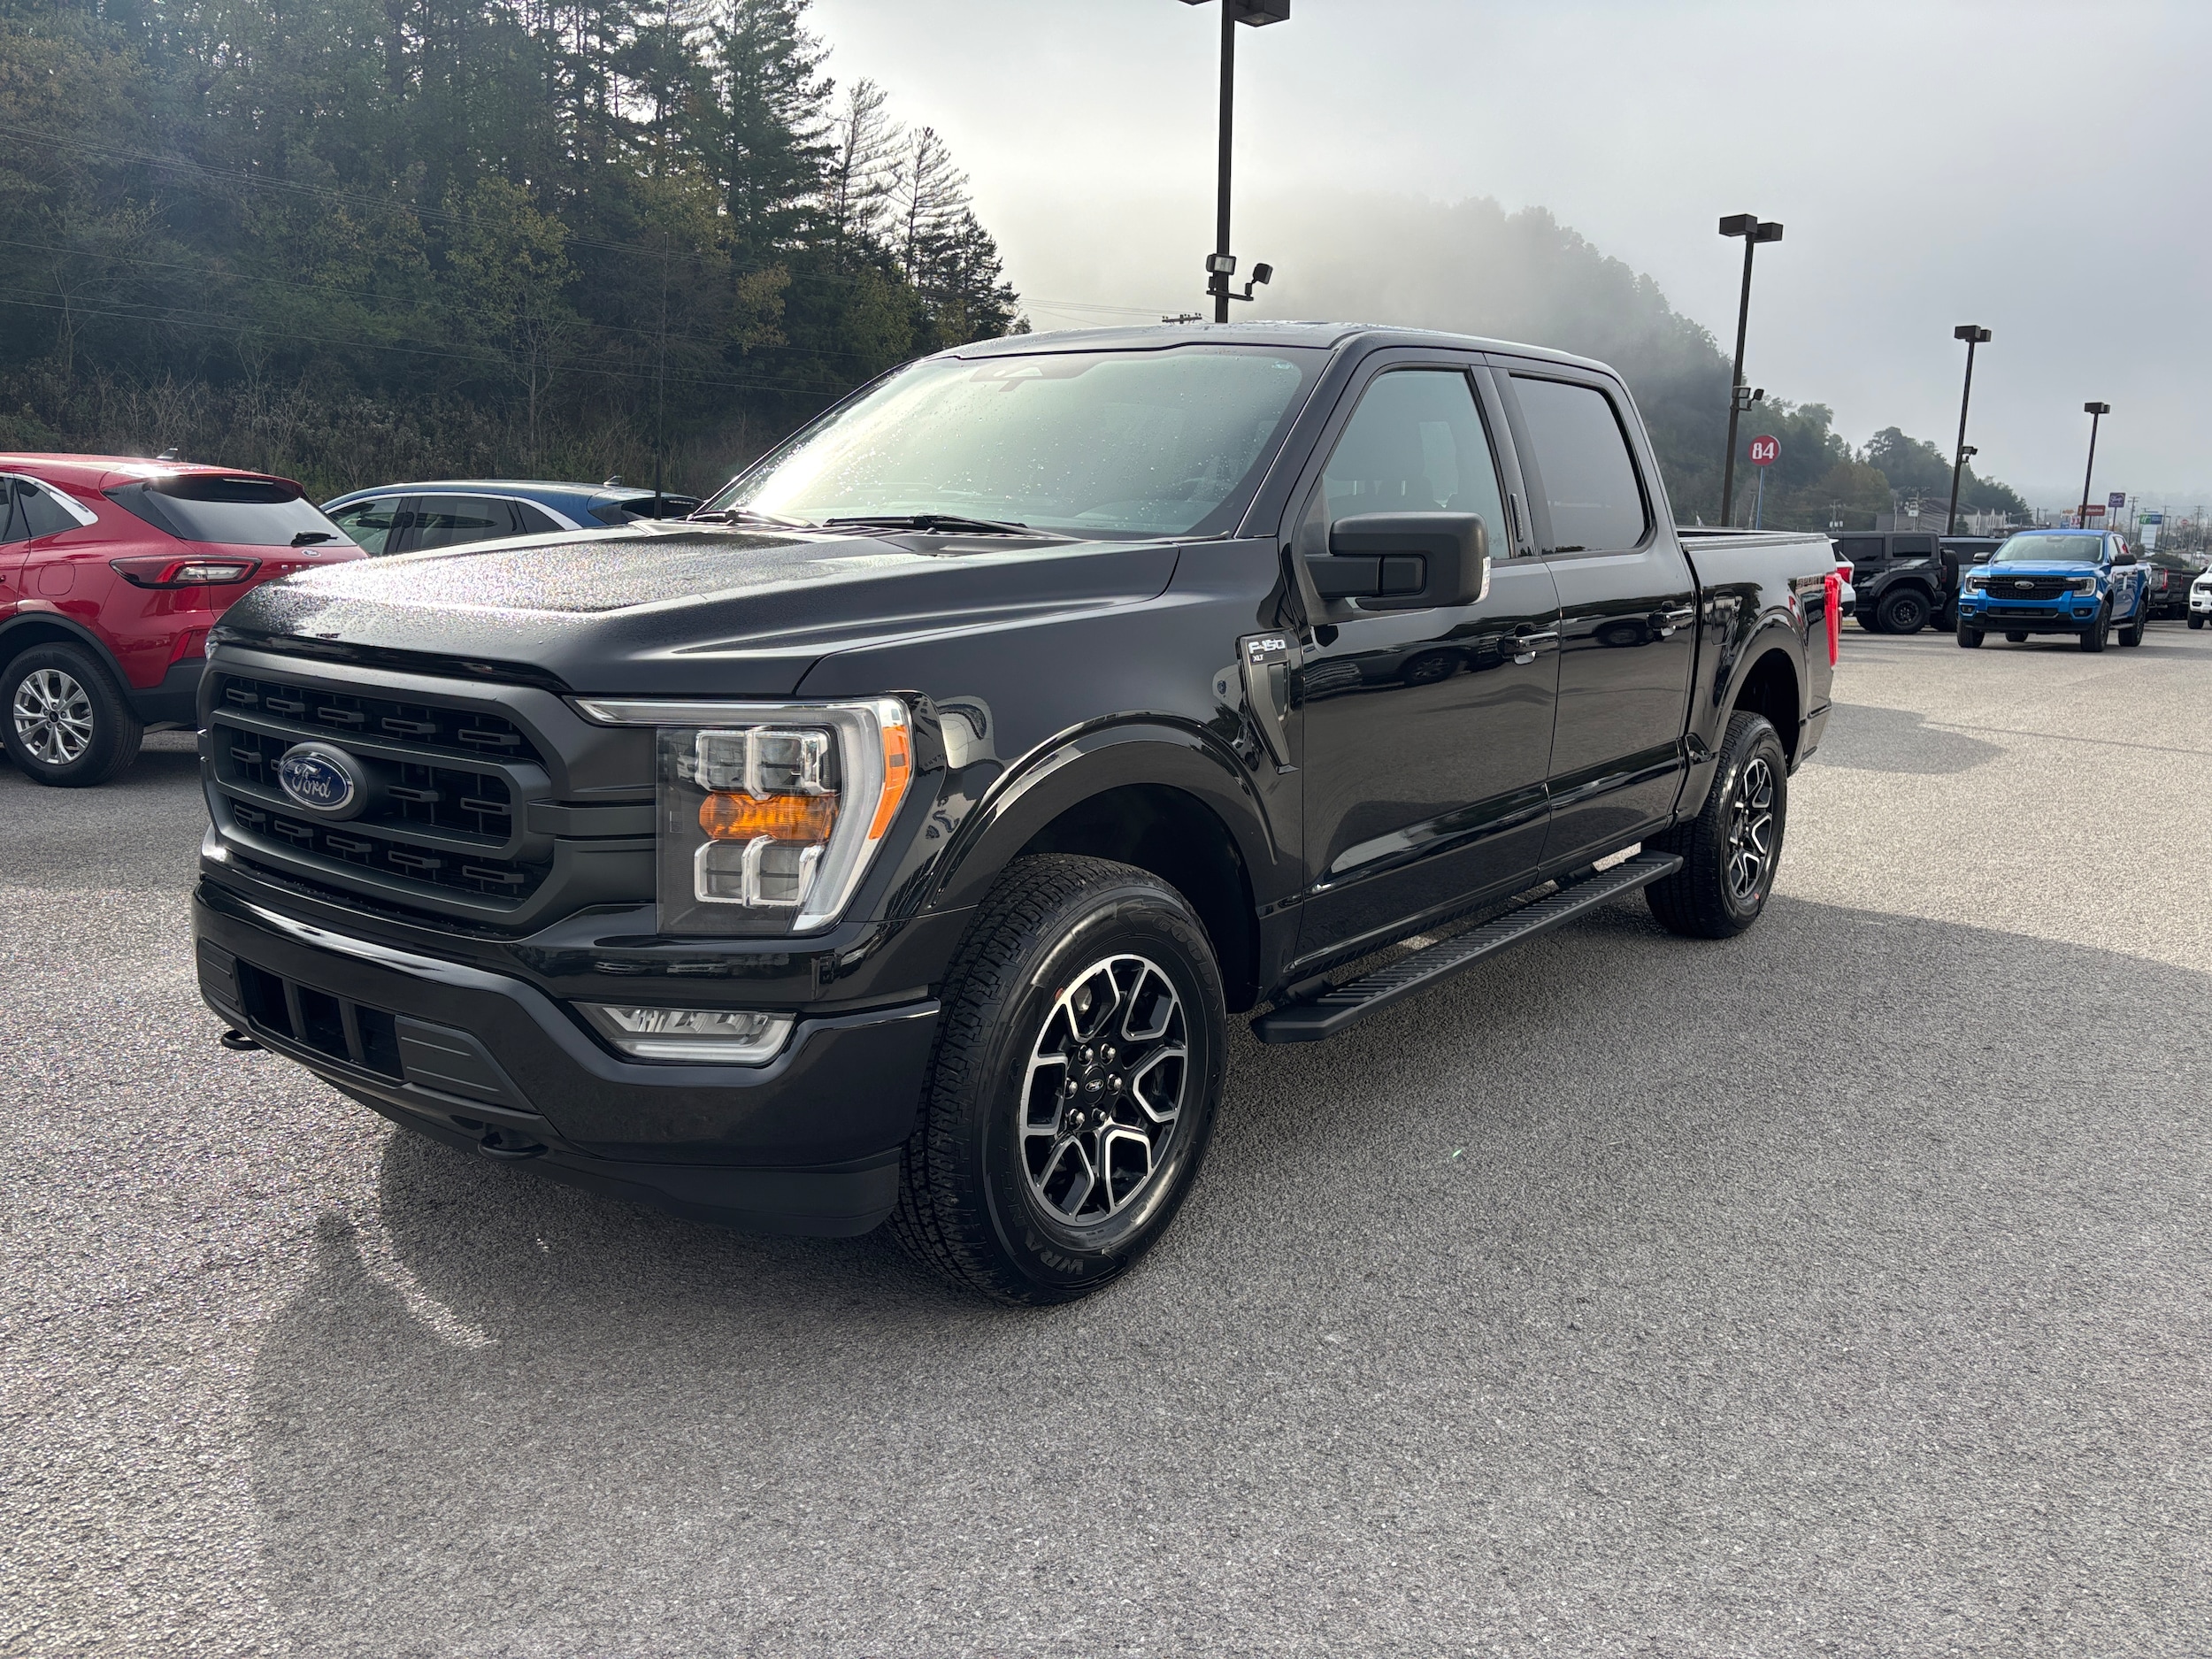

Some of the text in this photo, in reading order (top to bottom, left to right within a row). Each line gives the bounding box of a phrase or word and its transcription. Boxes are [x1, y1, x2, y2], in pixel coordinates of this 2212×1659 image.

[1752, 442, 1774, 459] 84
[1248, 639, 1286, 654] F-150
[1252, 654, 1263, 663] XLT
[291, 762, 331, 798] Ford
